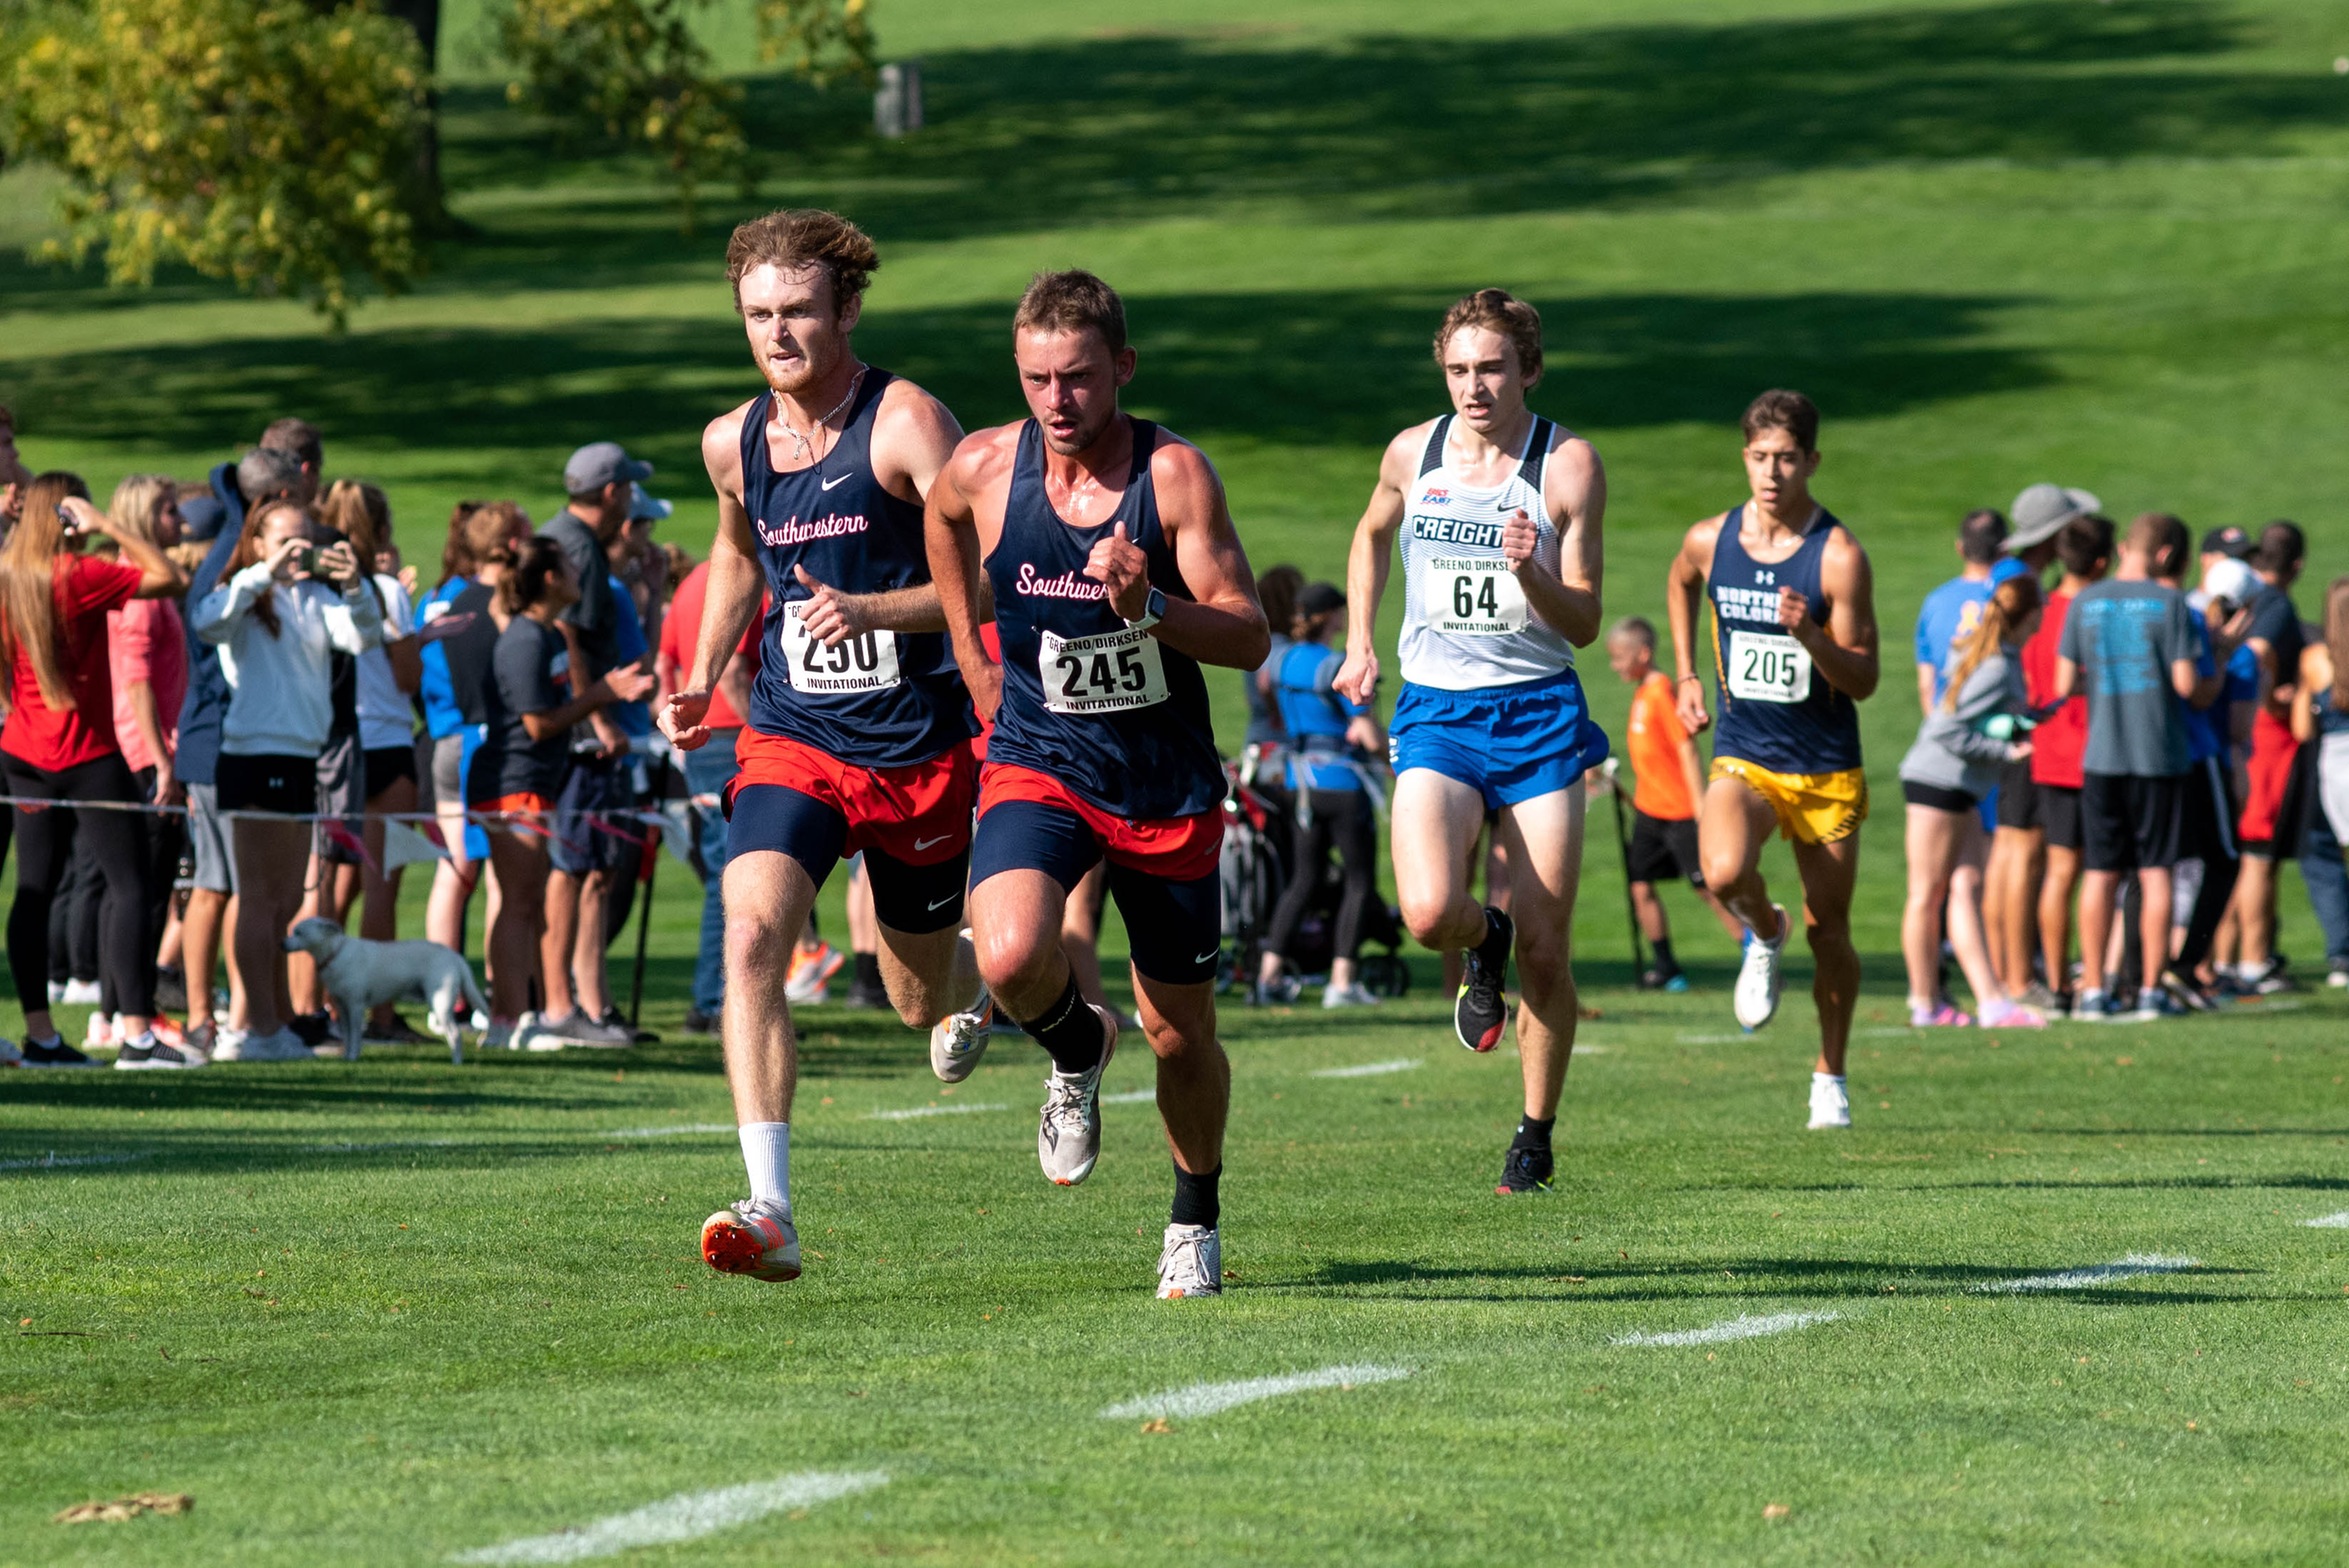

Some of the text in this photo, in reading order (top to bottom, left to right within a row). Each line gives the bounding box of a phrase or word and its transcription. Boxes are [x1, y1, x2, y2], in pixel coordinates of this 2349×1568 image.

[757, 512, 869, 547] Southwestern
[1413, 515, 1504, 548] CREIGHT
[1433, 559, 1509, 571] GREENO/DIRKS
[1016, 563, 1109, 600] Southwes
[1453, 575, 1499, 619] 64
[1716, 585, 1782, 608] NORTH
[1443, 621, 1511, 632] INVITATIONAL
[1720, 602, 1780, 624] COLOR
[798, 624, 879, 673] 250
[1049, 630, 1148, 653] GREENO/DIRKSEN
[1056, 646, 1146, 697] 245
[1743, 648, 1797, 687] 205
[807, 676, 882, 690] INVITATIONAL
[1066, 694, 1151, 711] INVITATIONAL
